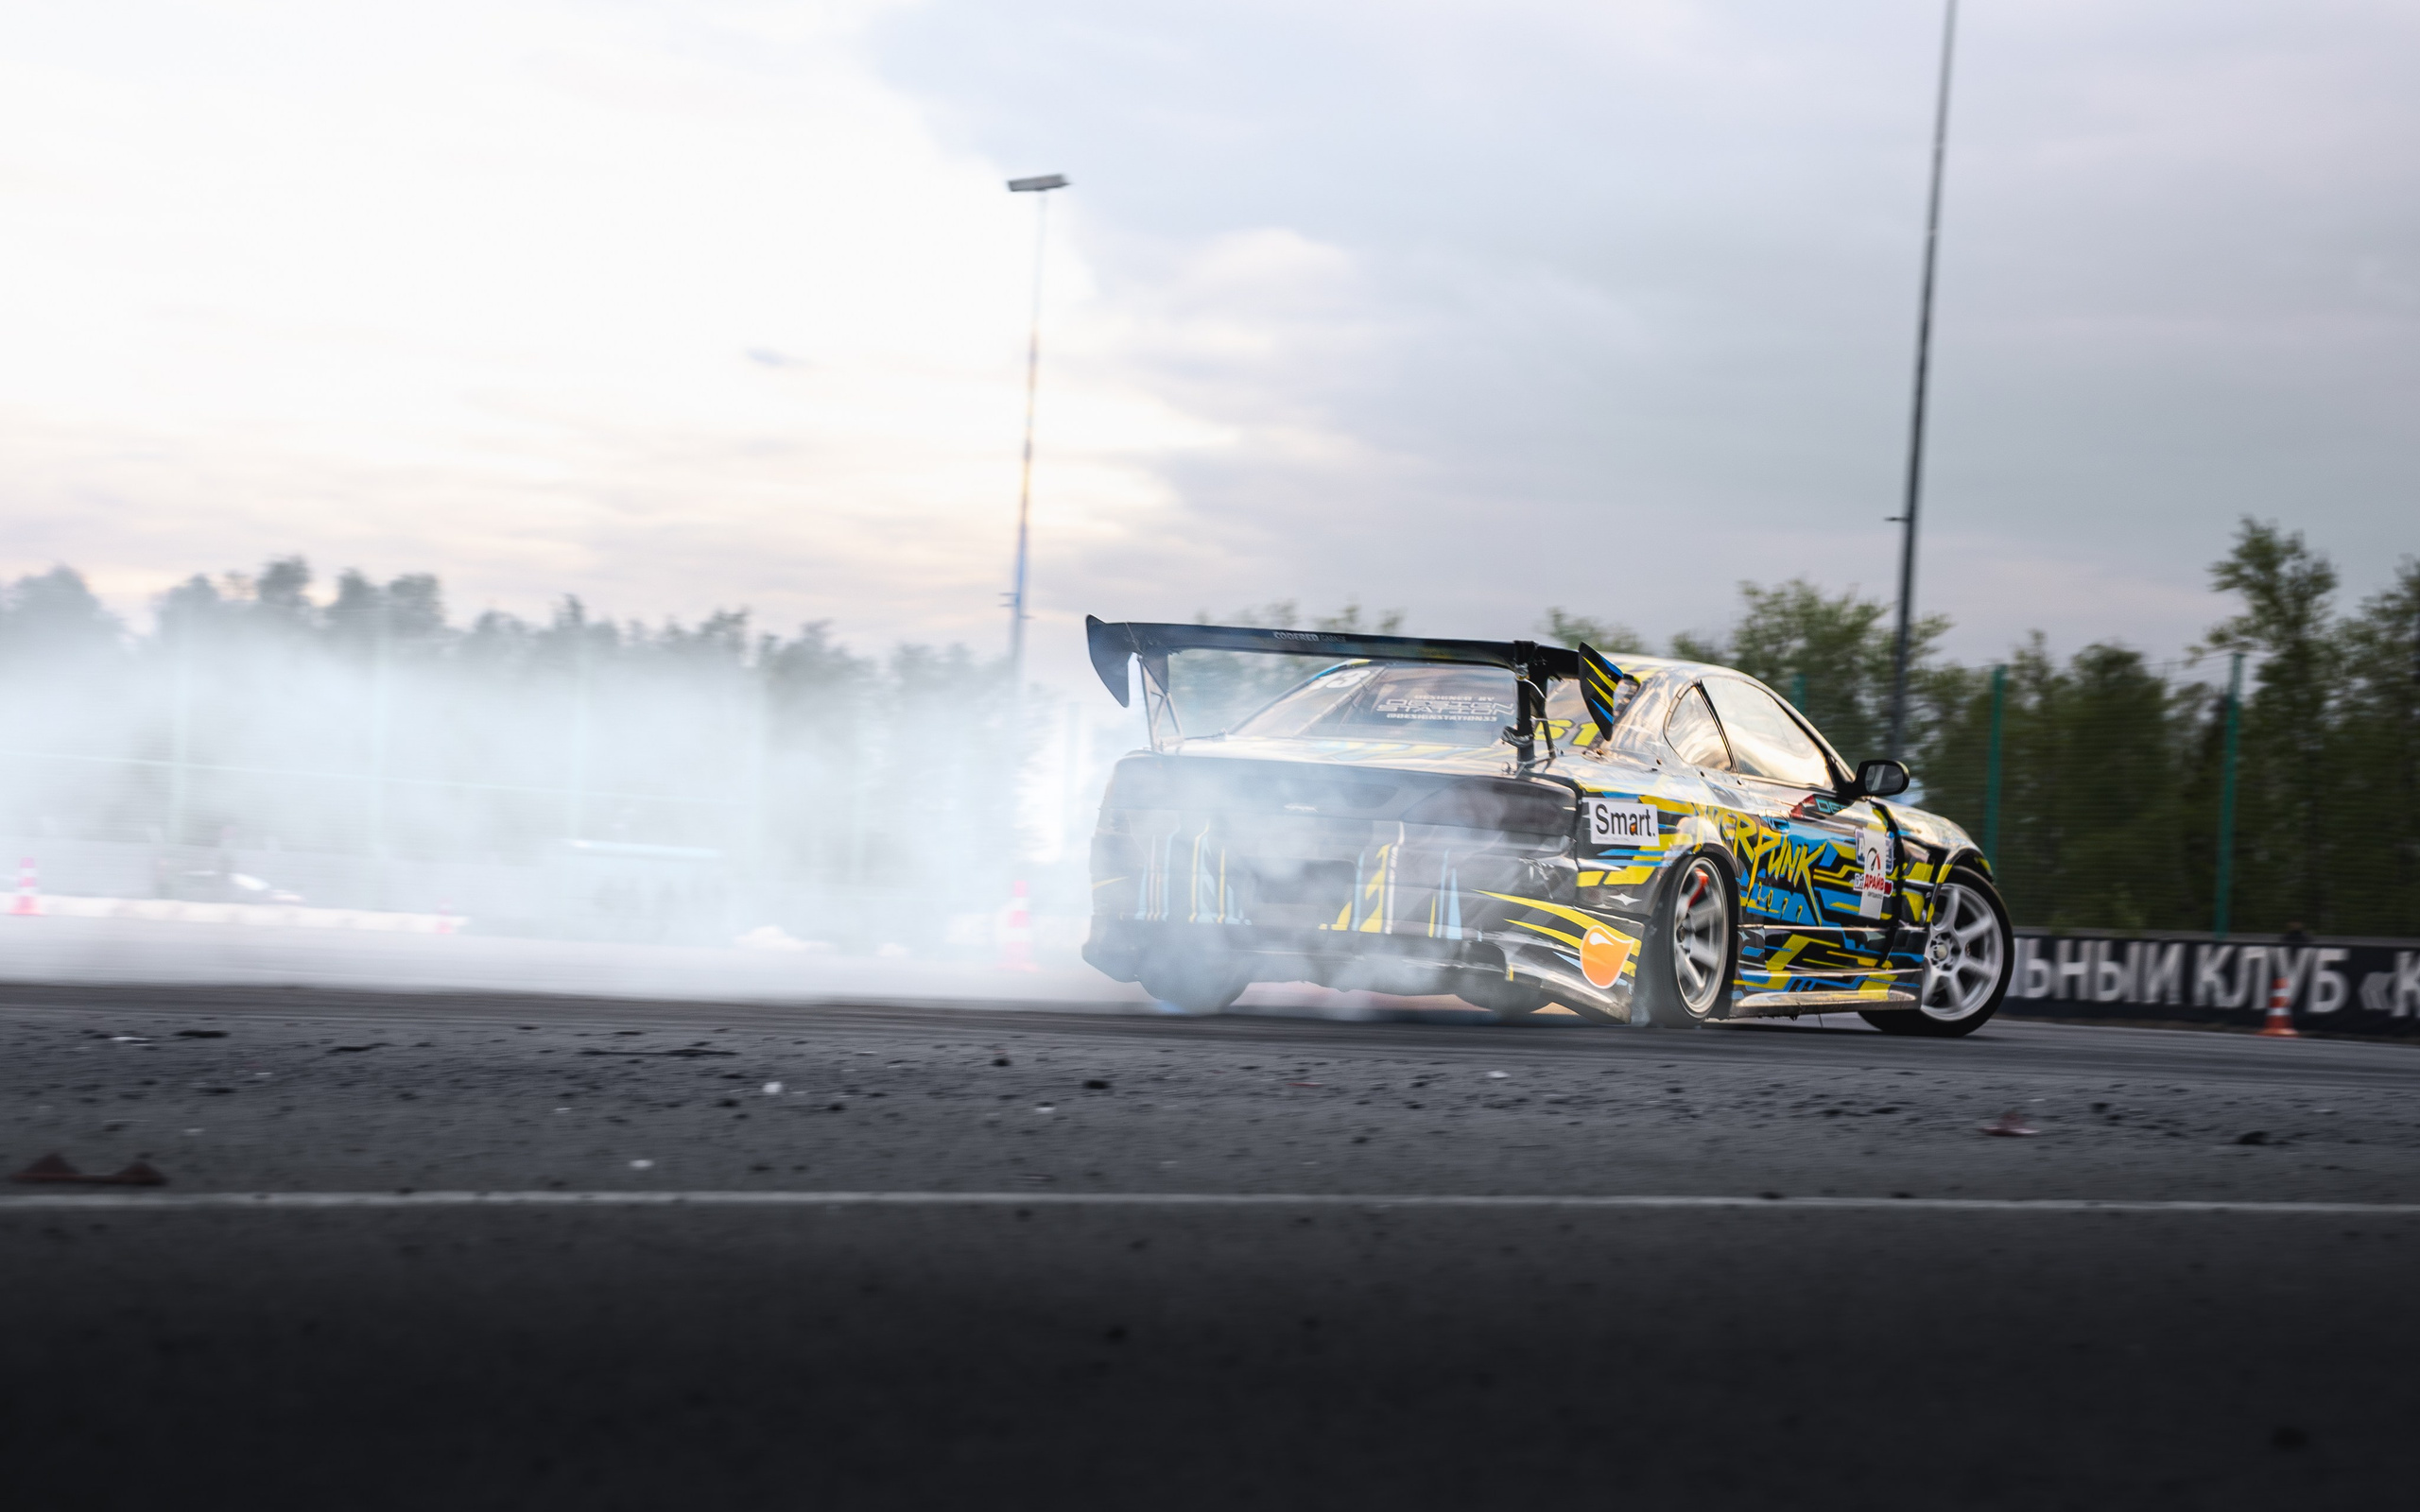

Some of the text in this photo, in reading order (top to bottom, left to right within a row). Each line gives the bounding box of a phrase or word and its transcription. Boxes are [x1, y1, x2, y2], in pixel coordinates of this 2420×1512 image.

[1595, 803, 1656, 837] Smart.
[1863, 872, 1885, 891] ДРАЙВ
[2194, 943, 2350, 1013] КЛУБ
